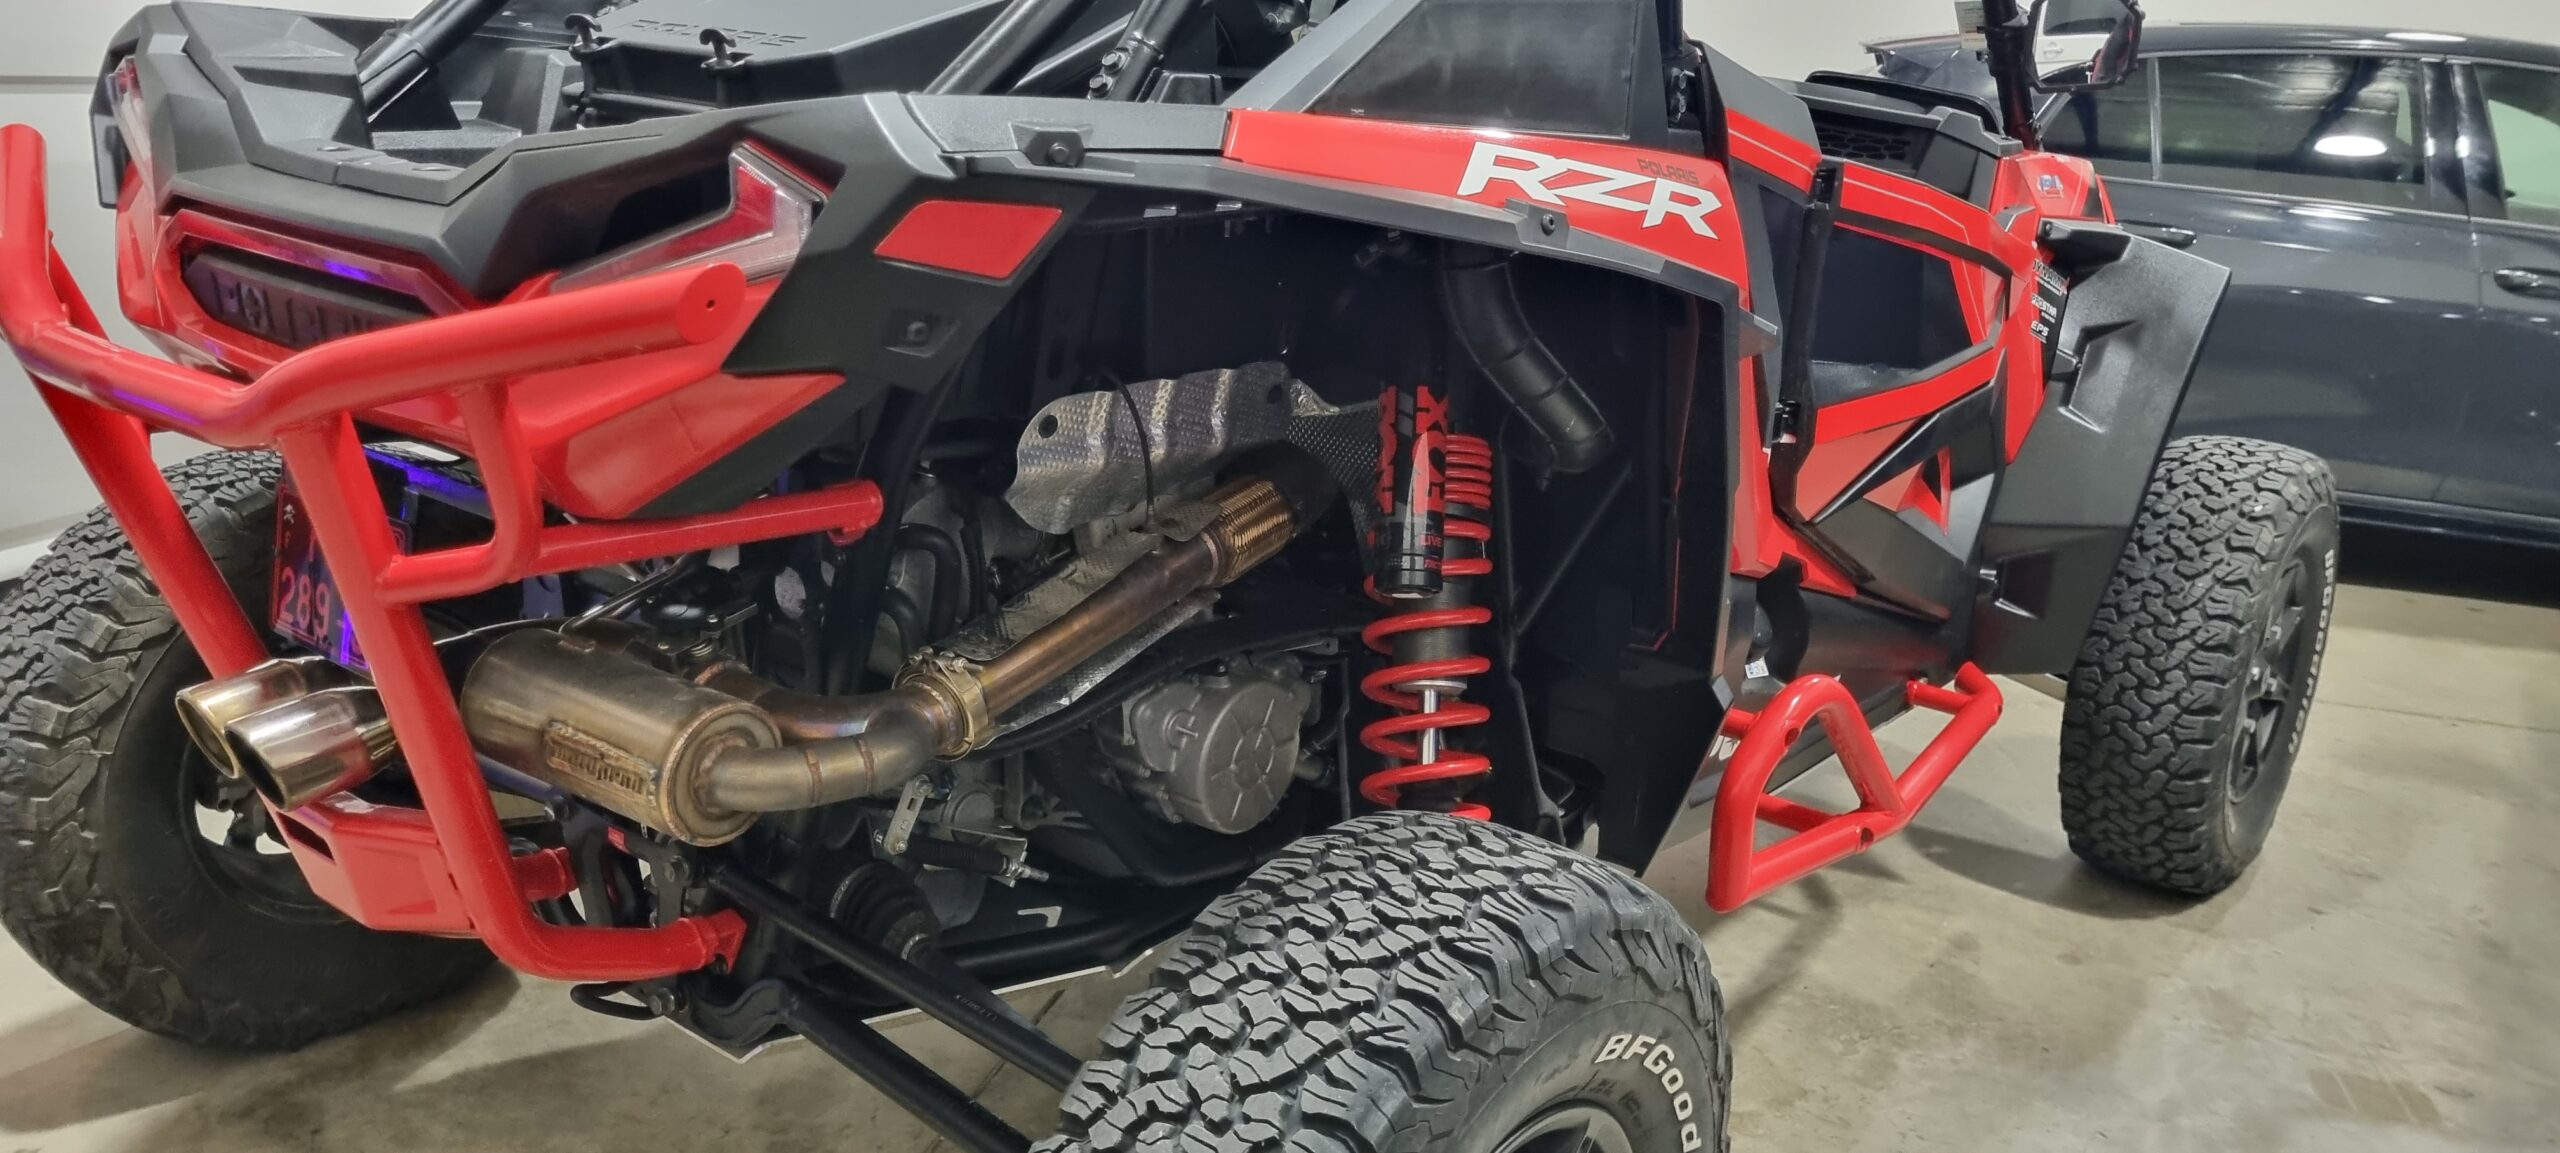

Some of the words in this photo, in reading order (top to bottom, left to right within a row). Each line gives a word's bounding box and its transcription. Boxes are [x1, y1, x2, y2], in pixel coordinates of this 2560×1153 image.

[1456, 141, 1723, 241] RZR
[1637, 158, 1700, 185] POLARIS
[2030, 320, 2050, 337] EPS
[1412, 385, 1449, 516] FOX
